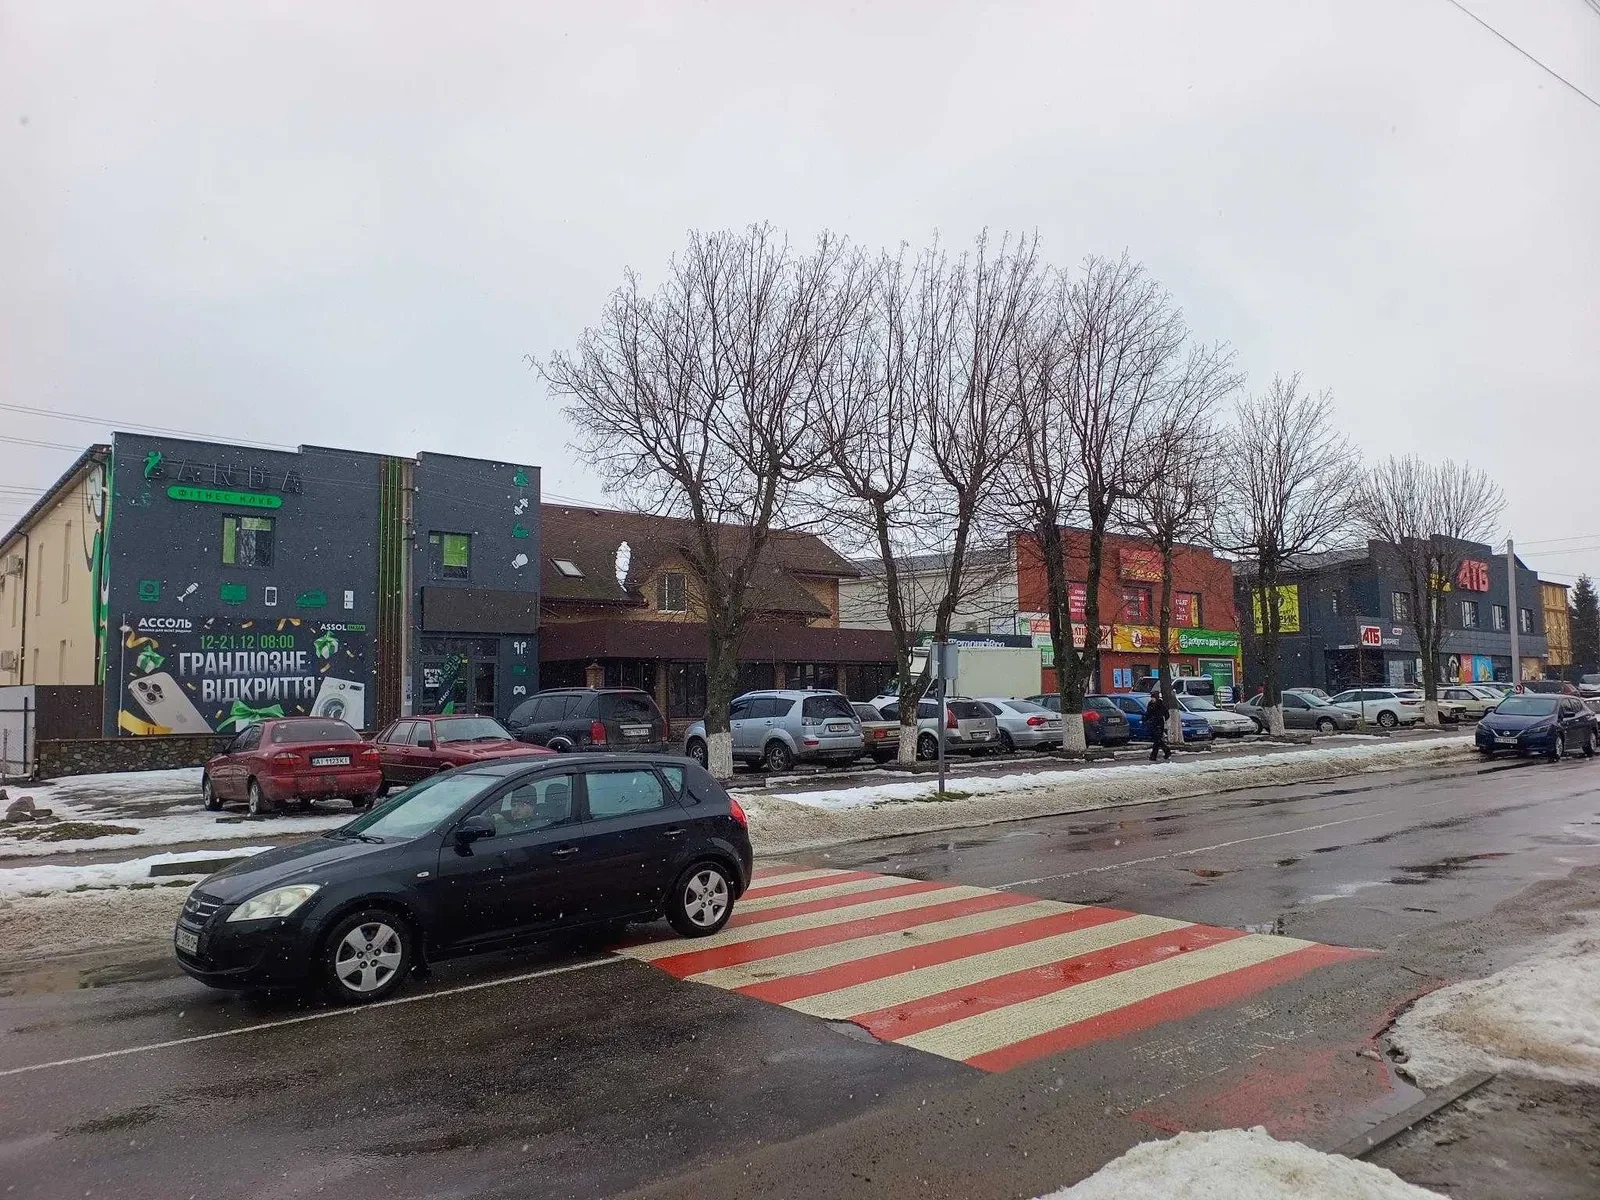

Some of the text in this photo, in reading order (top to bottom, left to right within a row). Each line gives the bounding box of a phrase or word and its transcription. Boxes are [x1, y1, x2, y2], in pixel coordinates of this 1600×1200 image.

[178, 489, 231, 501] ФІТНЕС
[1459, 559, 1489, 592] АТБ
[138, 617, 192, 628] АССОЛЬ
[320, 623, 347, 631] ASSOL
[200, 634, 295, 649] 12-21.12 08:00
[1362, 627, 1380, 644] АТБ
[179, 650, 308, 677] ГРАНДІОЗНЕ
[202, 676, 316, 703] ВІДКРИТТЯ
